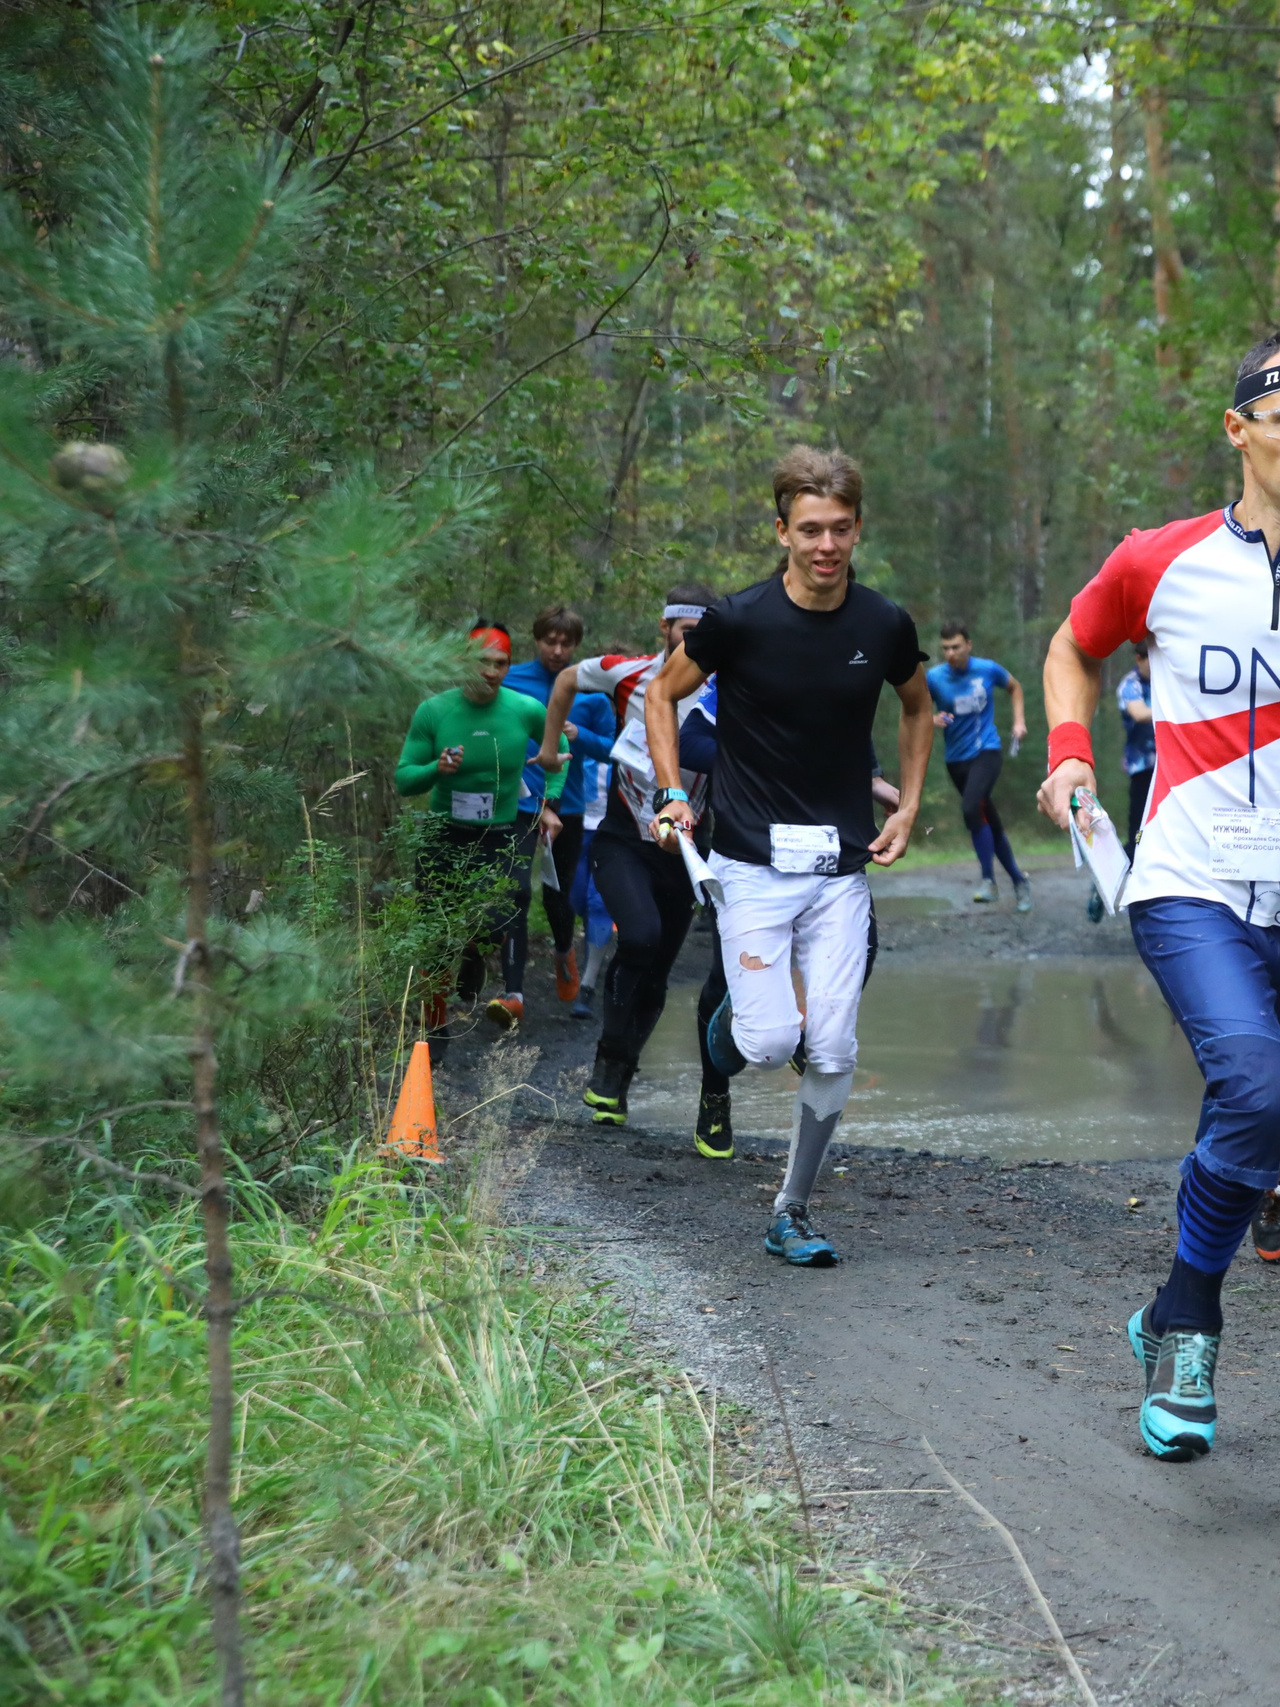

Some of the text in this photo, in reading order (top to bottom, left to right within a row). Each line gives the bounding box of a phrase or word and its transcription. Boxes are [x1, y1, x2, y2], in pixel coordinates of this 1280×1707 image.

[477, 810, 489, 819] 13
[1212, 825, 1251, 834] МУЖЧИНЫ
[814, 855, 839, 873] 22
